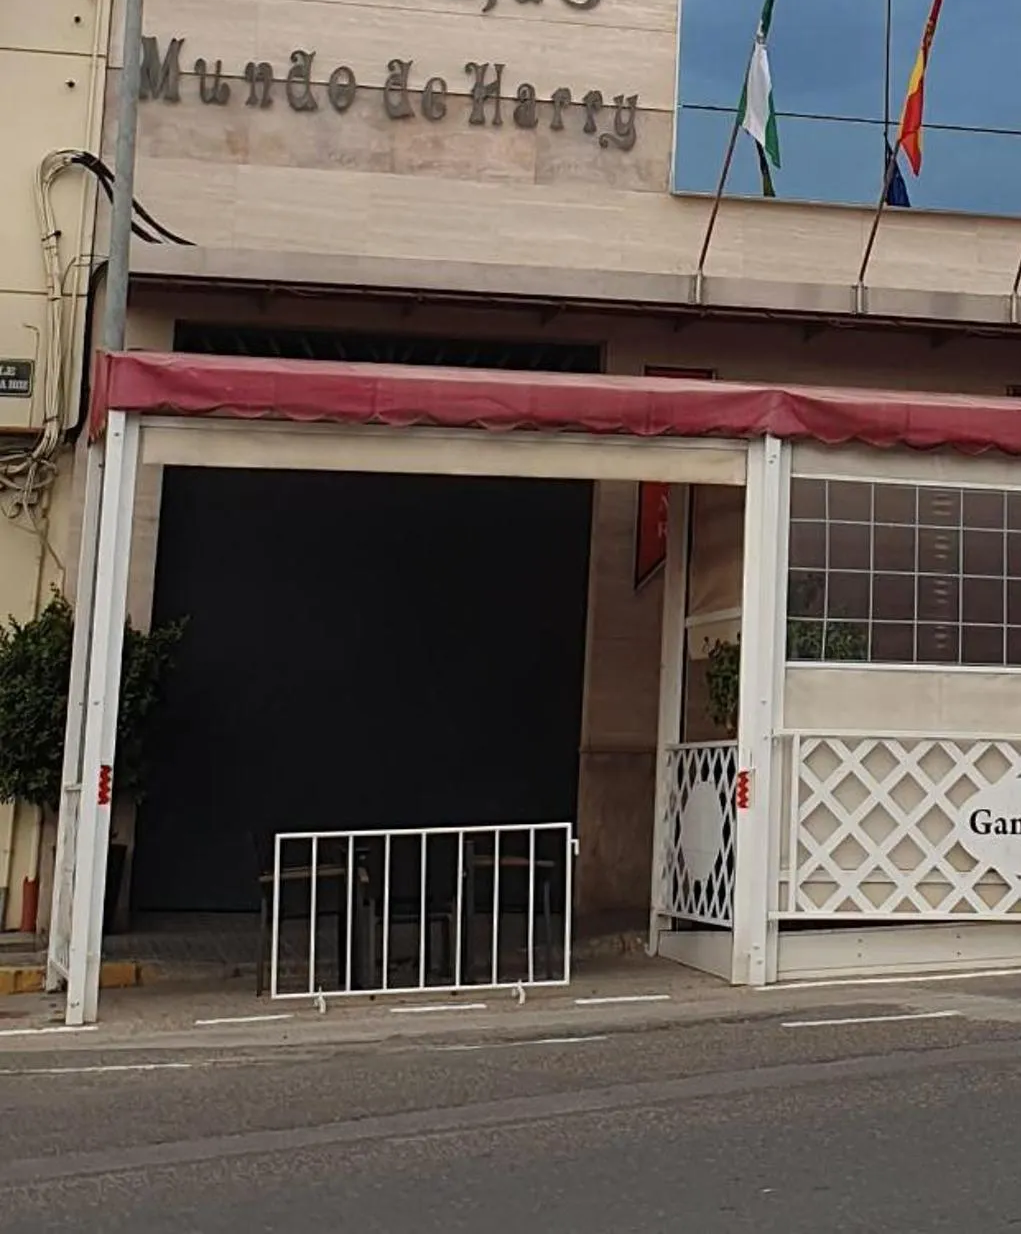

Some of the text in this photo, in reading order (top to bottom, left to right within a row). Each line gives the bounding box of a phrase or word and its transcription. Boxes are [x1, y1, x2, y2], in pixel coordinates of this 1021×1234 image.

[138, 35, 638, 152] Mundo de Harry
